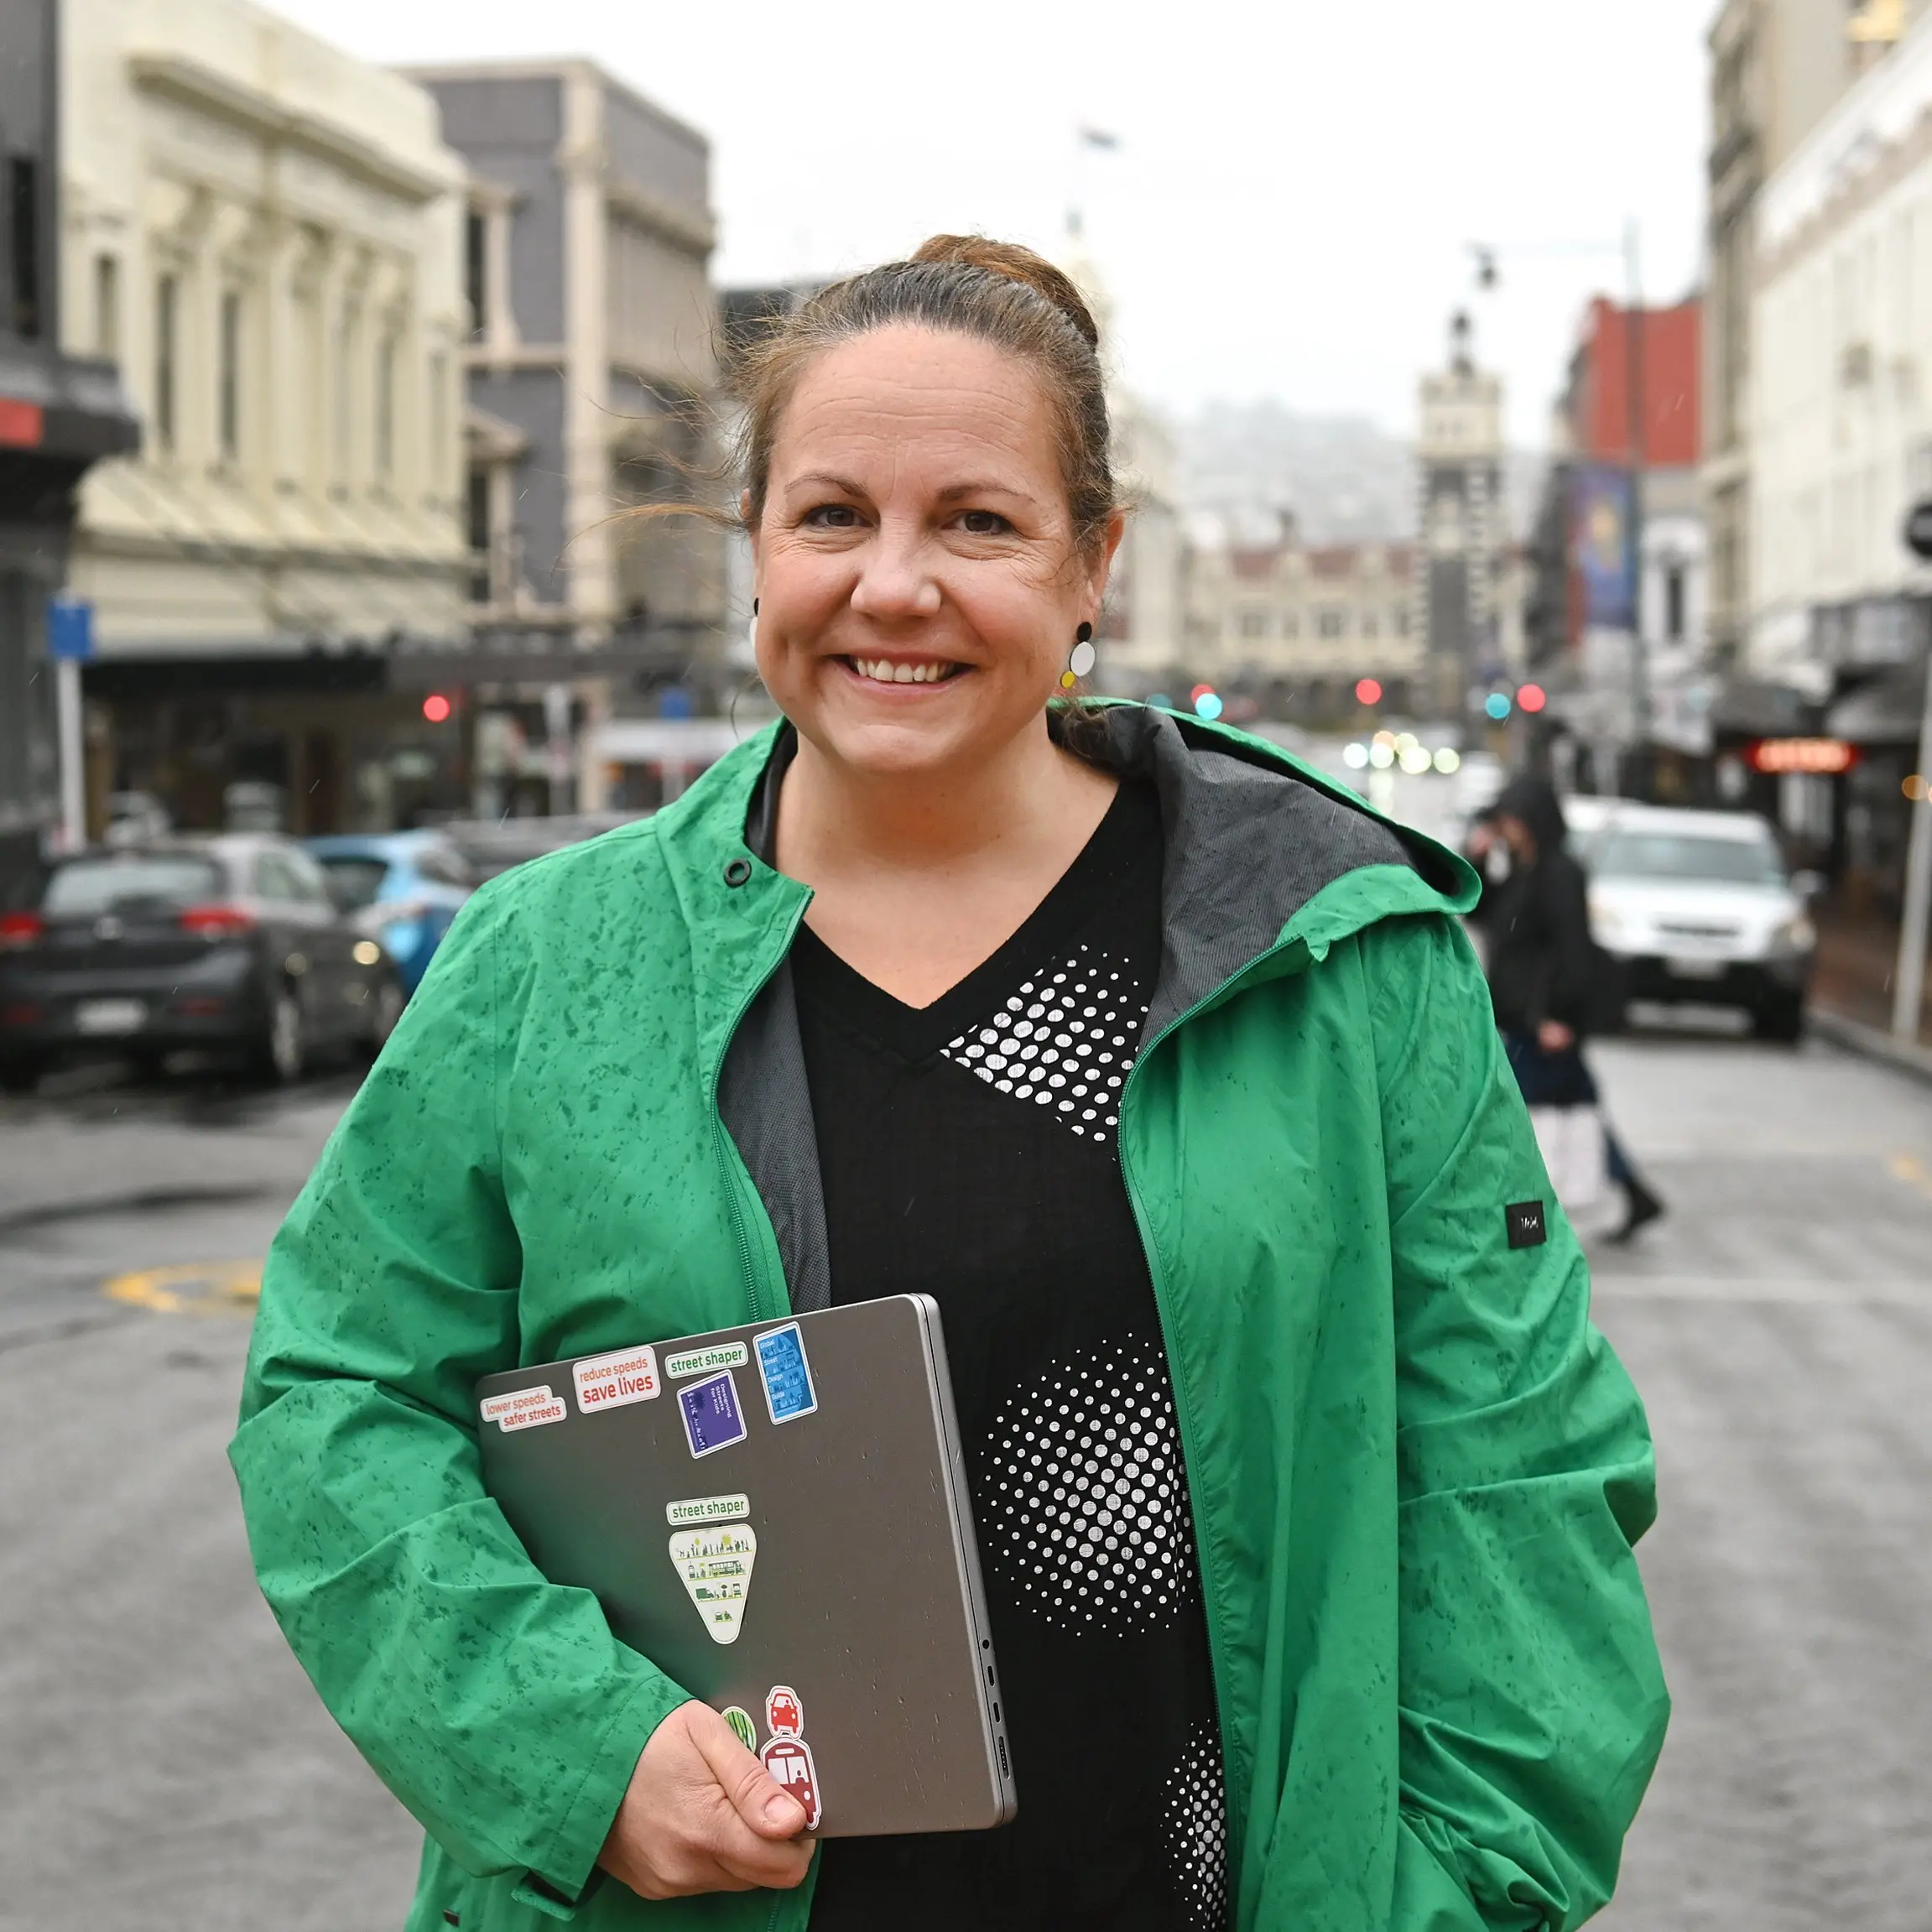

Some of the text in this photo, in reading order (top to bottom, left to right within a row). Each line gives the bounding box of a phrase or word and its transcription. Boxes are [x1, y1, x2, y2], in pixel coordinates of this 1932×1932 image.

[580, 1357, 648, 1383] reduce speeds
[671, 1349, 742, 1372] street shaper
[763, 1357, 779, 1366] Street
[583, 1375, 654, 1403] save lives
[715, 1385, 725, 1411] Streets
[486, 1393, 546, 1415] lower speeds
[720, 1383, 732, 1419] Designing
[503, 1405, 561, 1426] safer streets
[672, 1500, 745, 1518] street shaper
